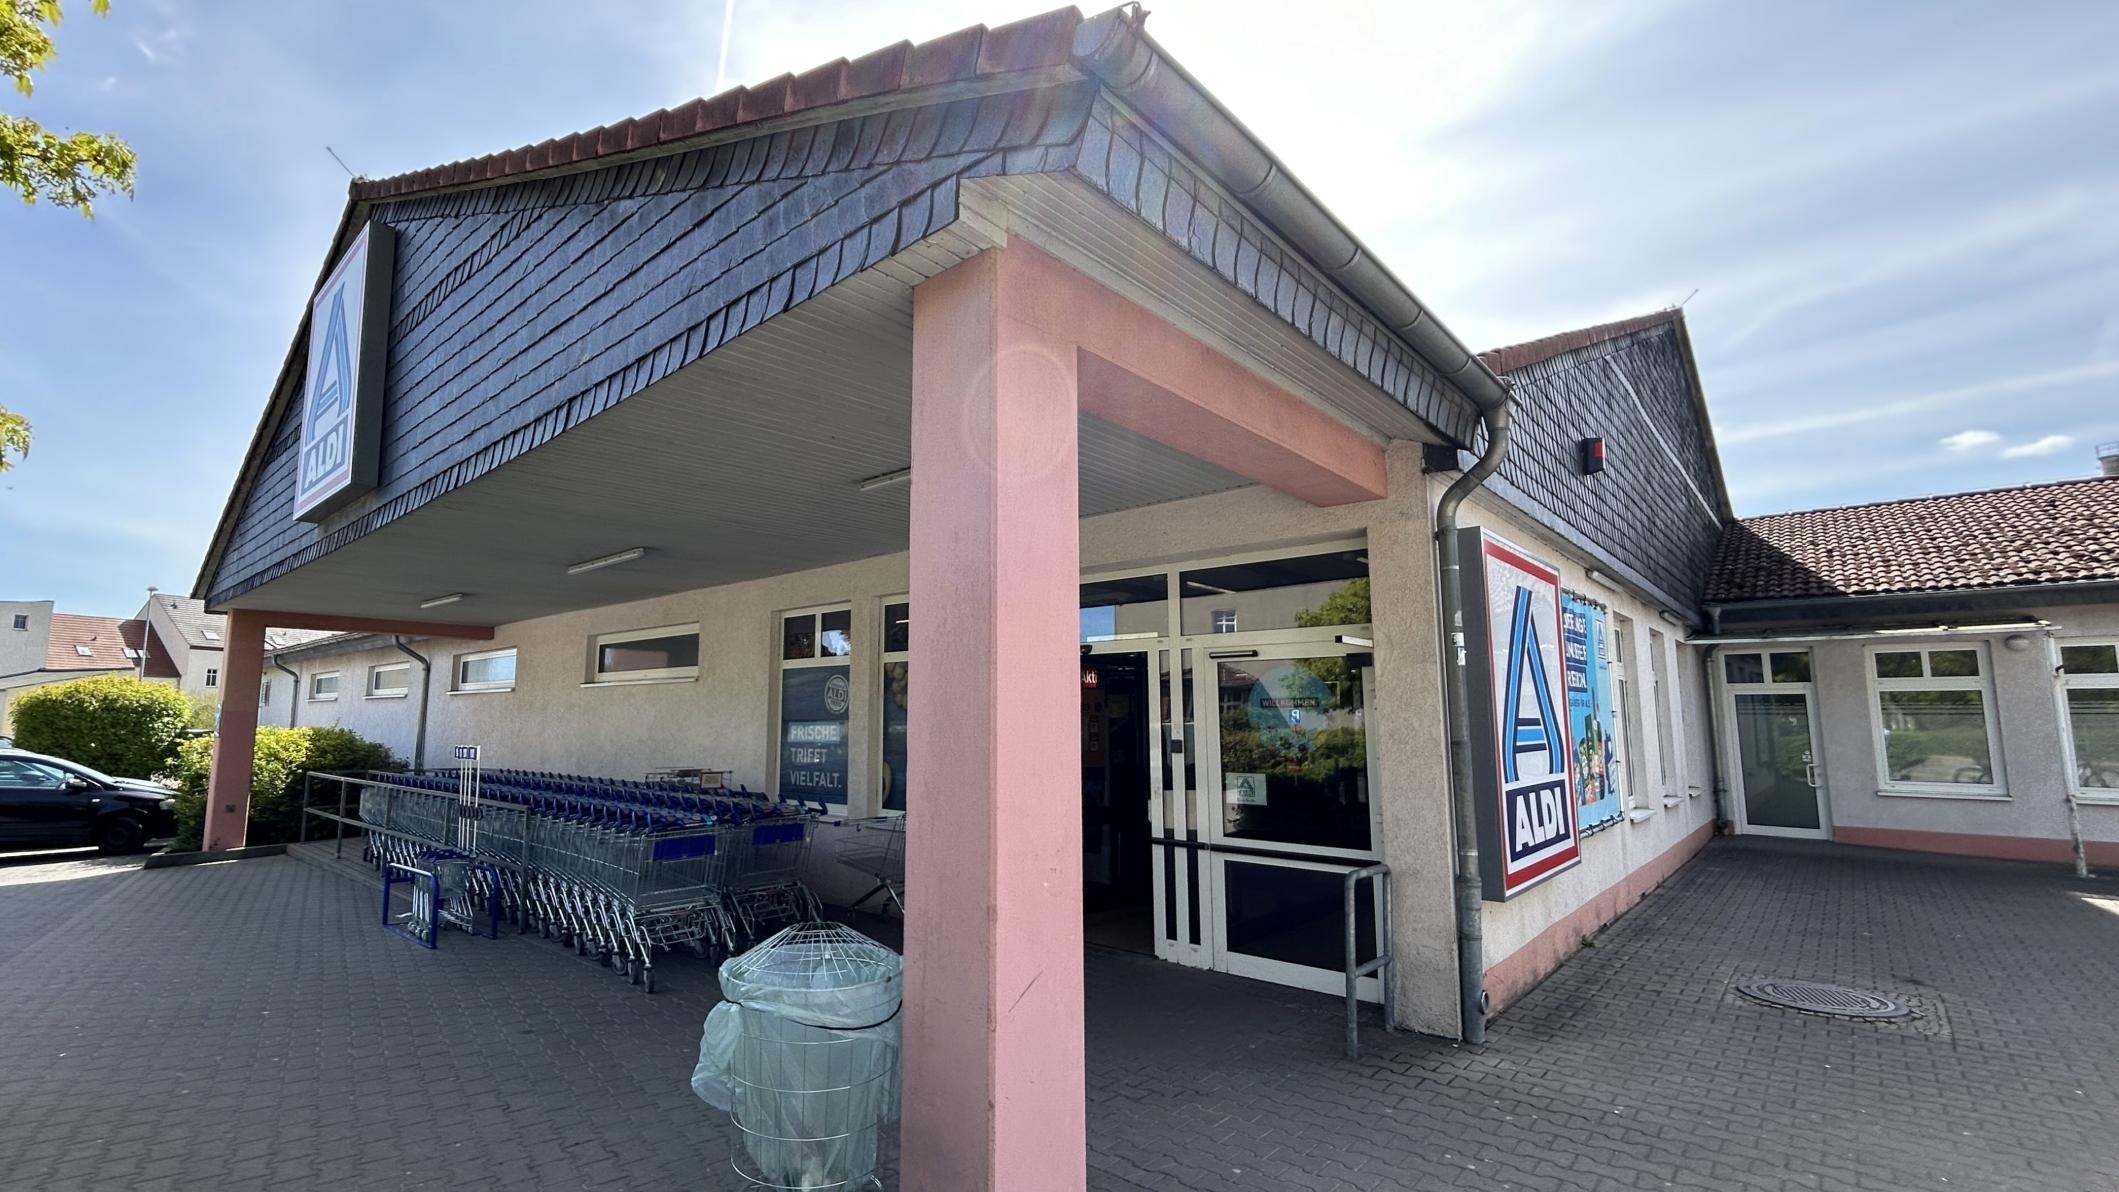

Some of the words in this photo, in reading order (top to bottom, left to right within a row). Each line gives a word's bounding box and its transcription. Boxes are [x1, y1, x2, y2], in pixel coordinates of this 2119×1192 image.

[304, 423, 344, 488] ALDI
[791, 725, 837, 741] FRISCHE
[790, 770, 842, 787] VIELFALT.
[1516, 787, 1566, 852] ALDI
